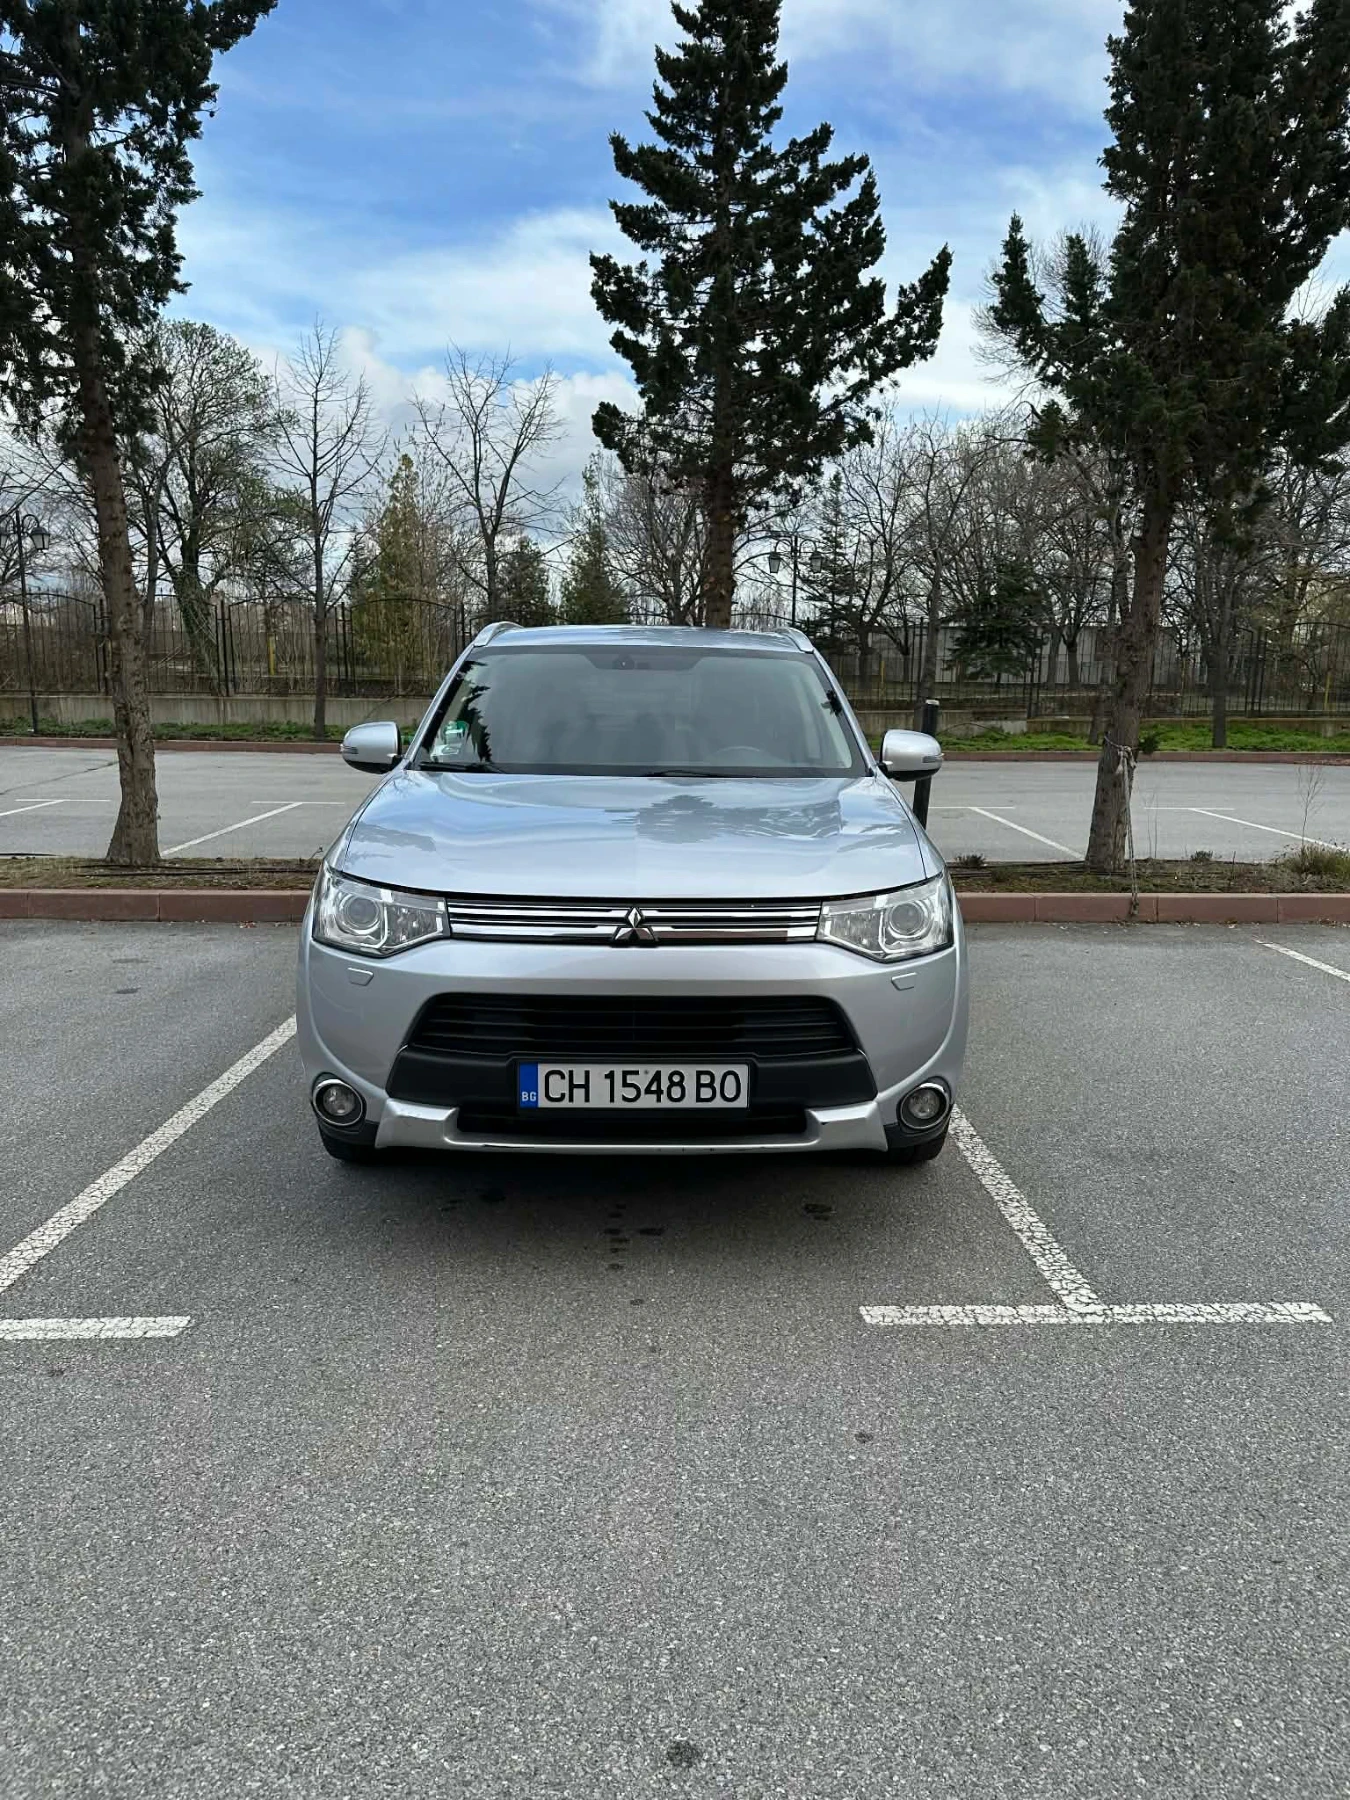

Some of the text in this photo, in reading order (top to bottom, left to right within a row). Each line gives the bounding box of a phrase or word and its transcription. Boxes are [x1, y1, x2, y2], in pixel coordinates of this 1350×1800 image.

[521, 1091, 537, 1102] BG
[544, 1069, 591, 1103] CH
[604, 1069, 687, 1103] 1548
